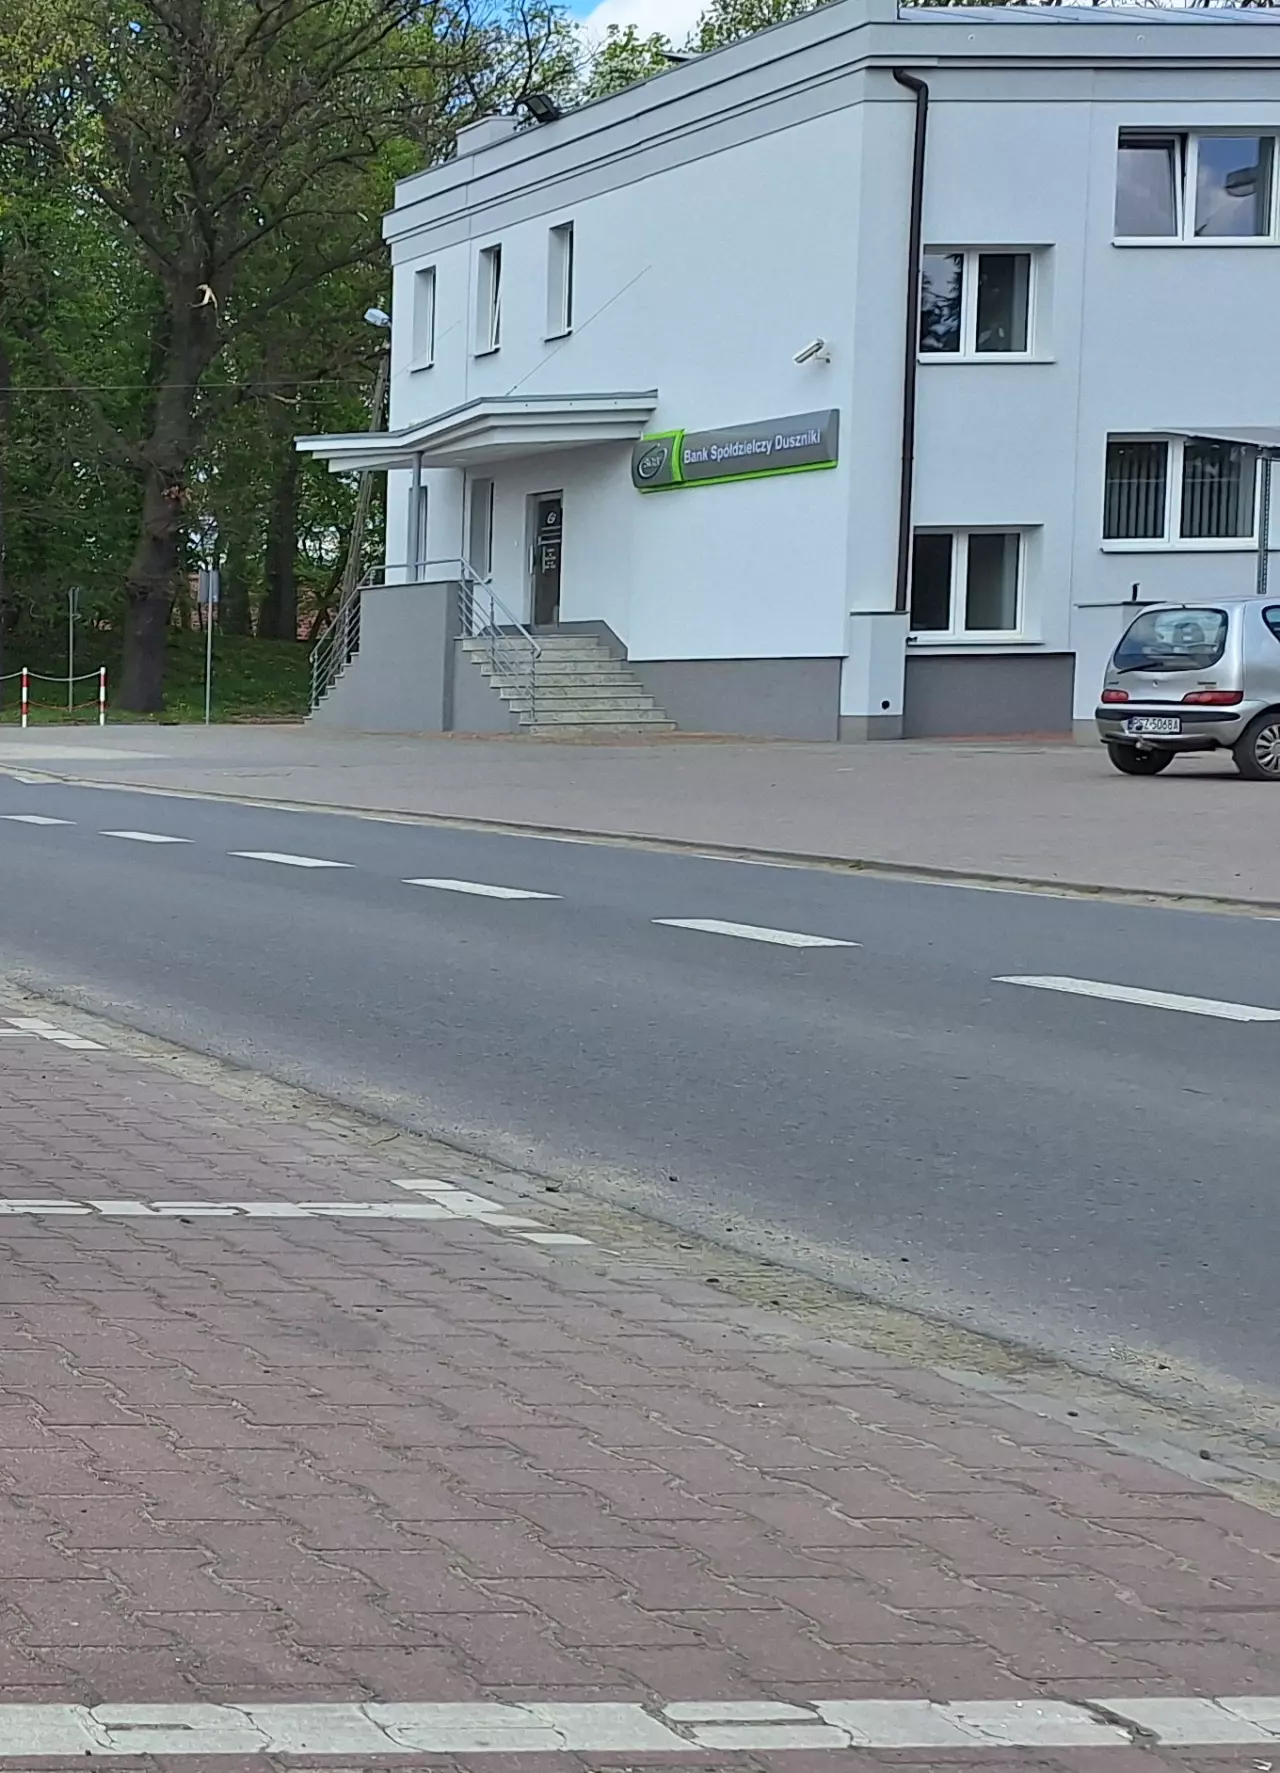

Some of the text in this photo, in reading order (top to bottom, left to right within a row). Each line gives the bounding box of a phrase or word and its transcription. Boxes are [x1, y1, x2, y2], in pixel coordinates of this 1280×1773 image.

[683, 449, 709, 464] Bank
[710, 438, 773, 463] Spółdzielczy
[775, 429, 821, 450] Duszniki
